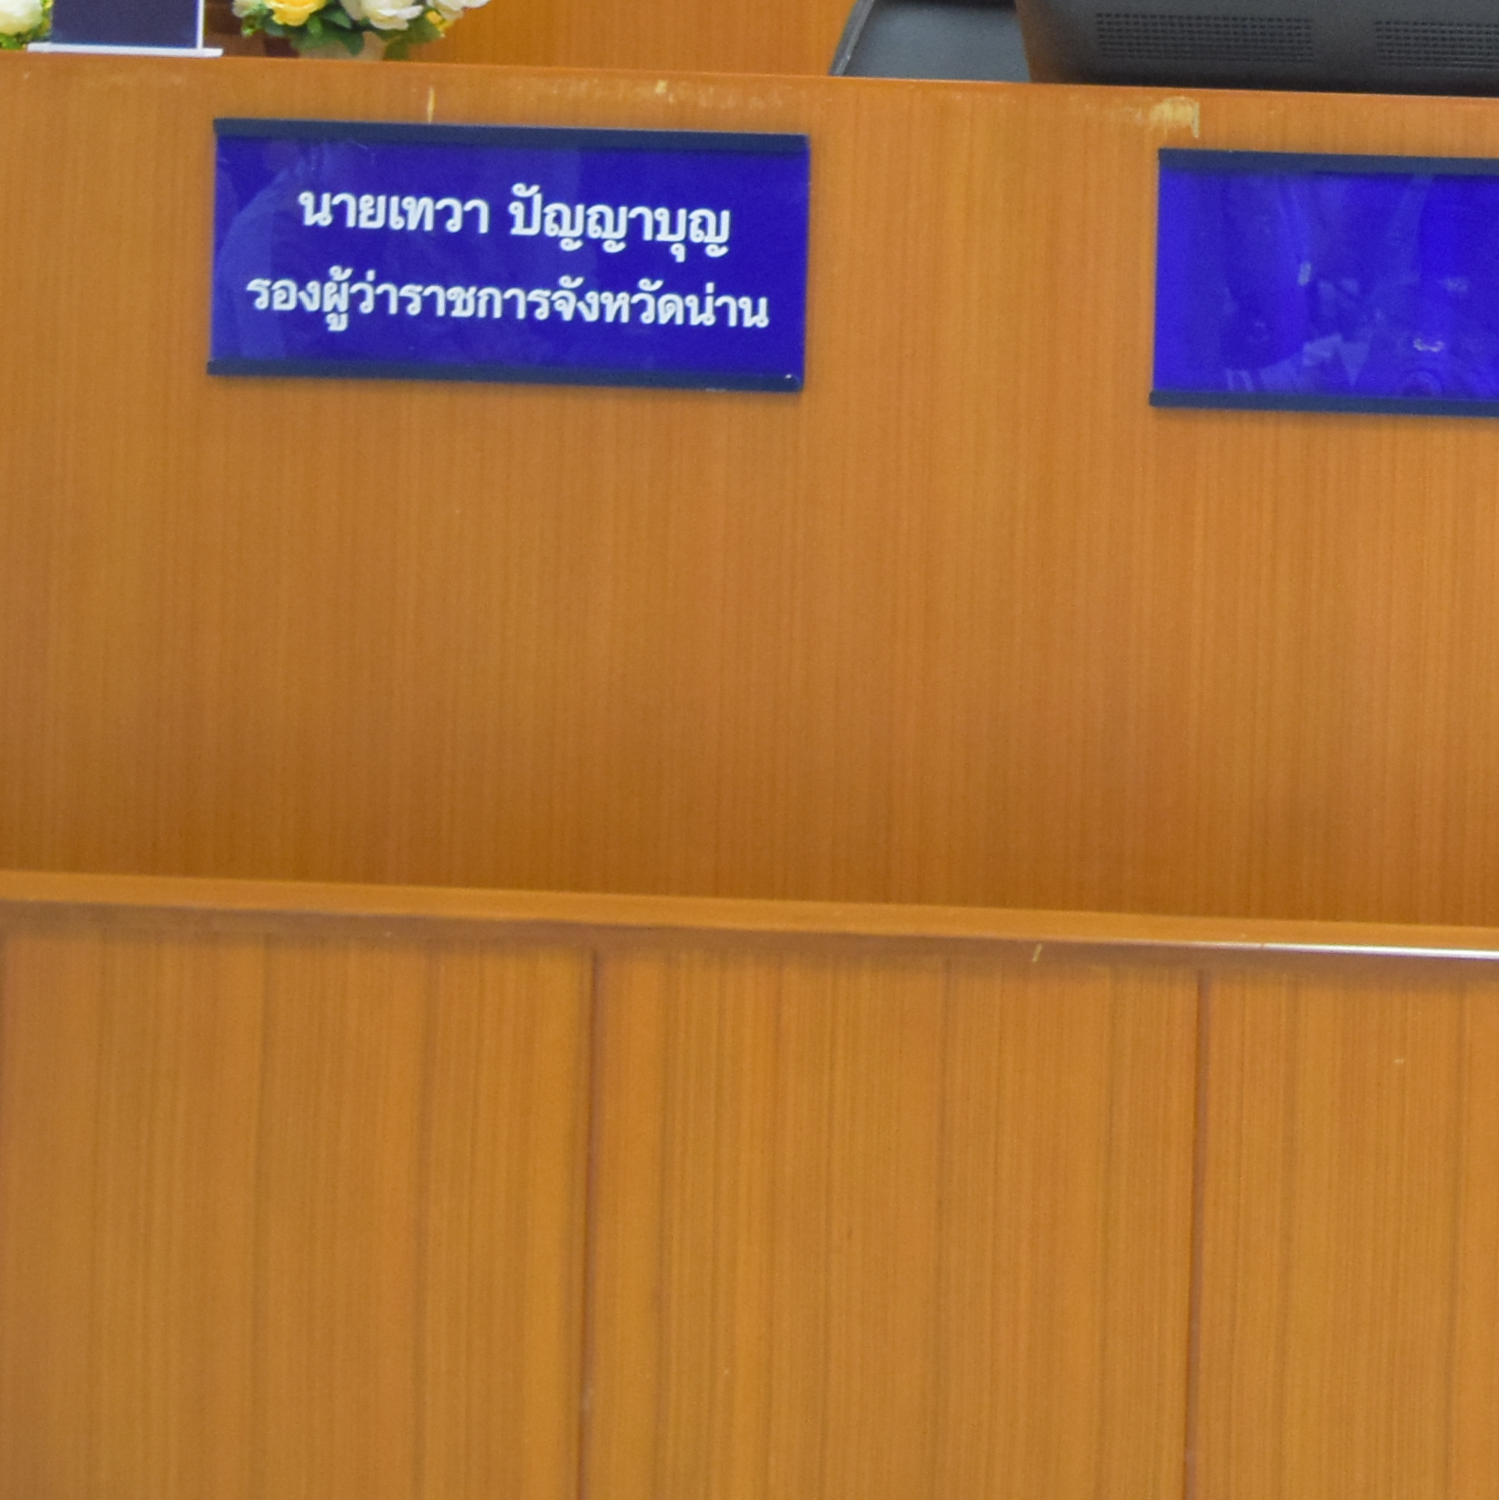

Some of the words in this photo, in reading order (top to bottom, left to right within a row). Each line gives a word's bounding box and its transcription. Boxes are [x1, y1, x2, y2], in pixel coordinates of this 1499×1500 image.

[298, 190, 490, 234] นายเทวา
[508, 182, 731, 262] ปัญญาบุญ
[246, 265, 770, 332] รองผู้ว่าราชการจังหวัดน่าน
